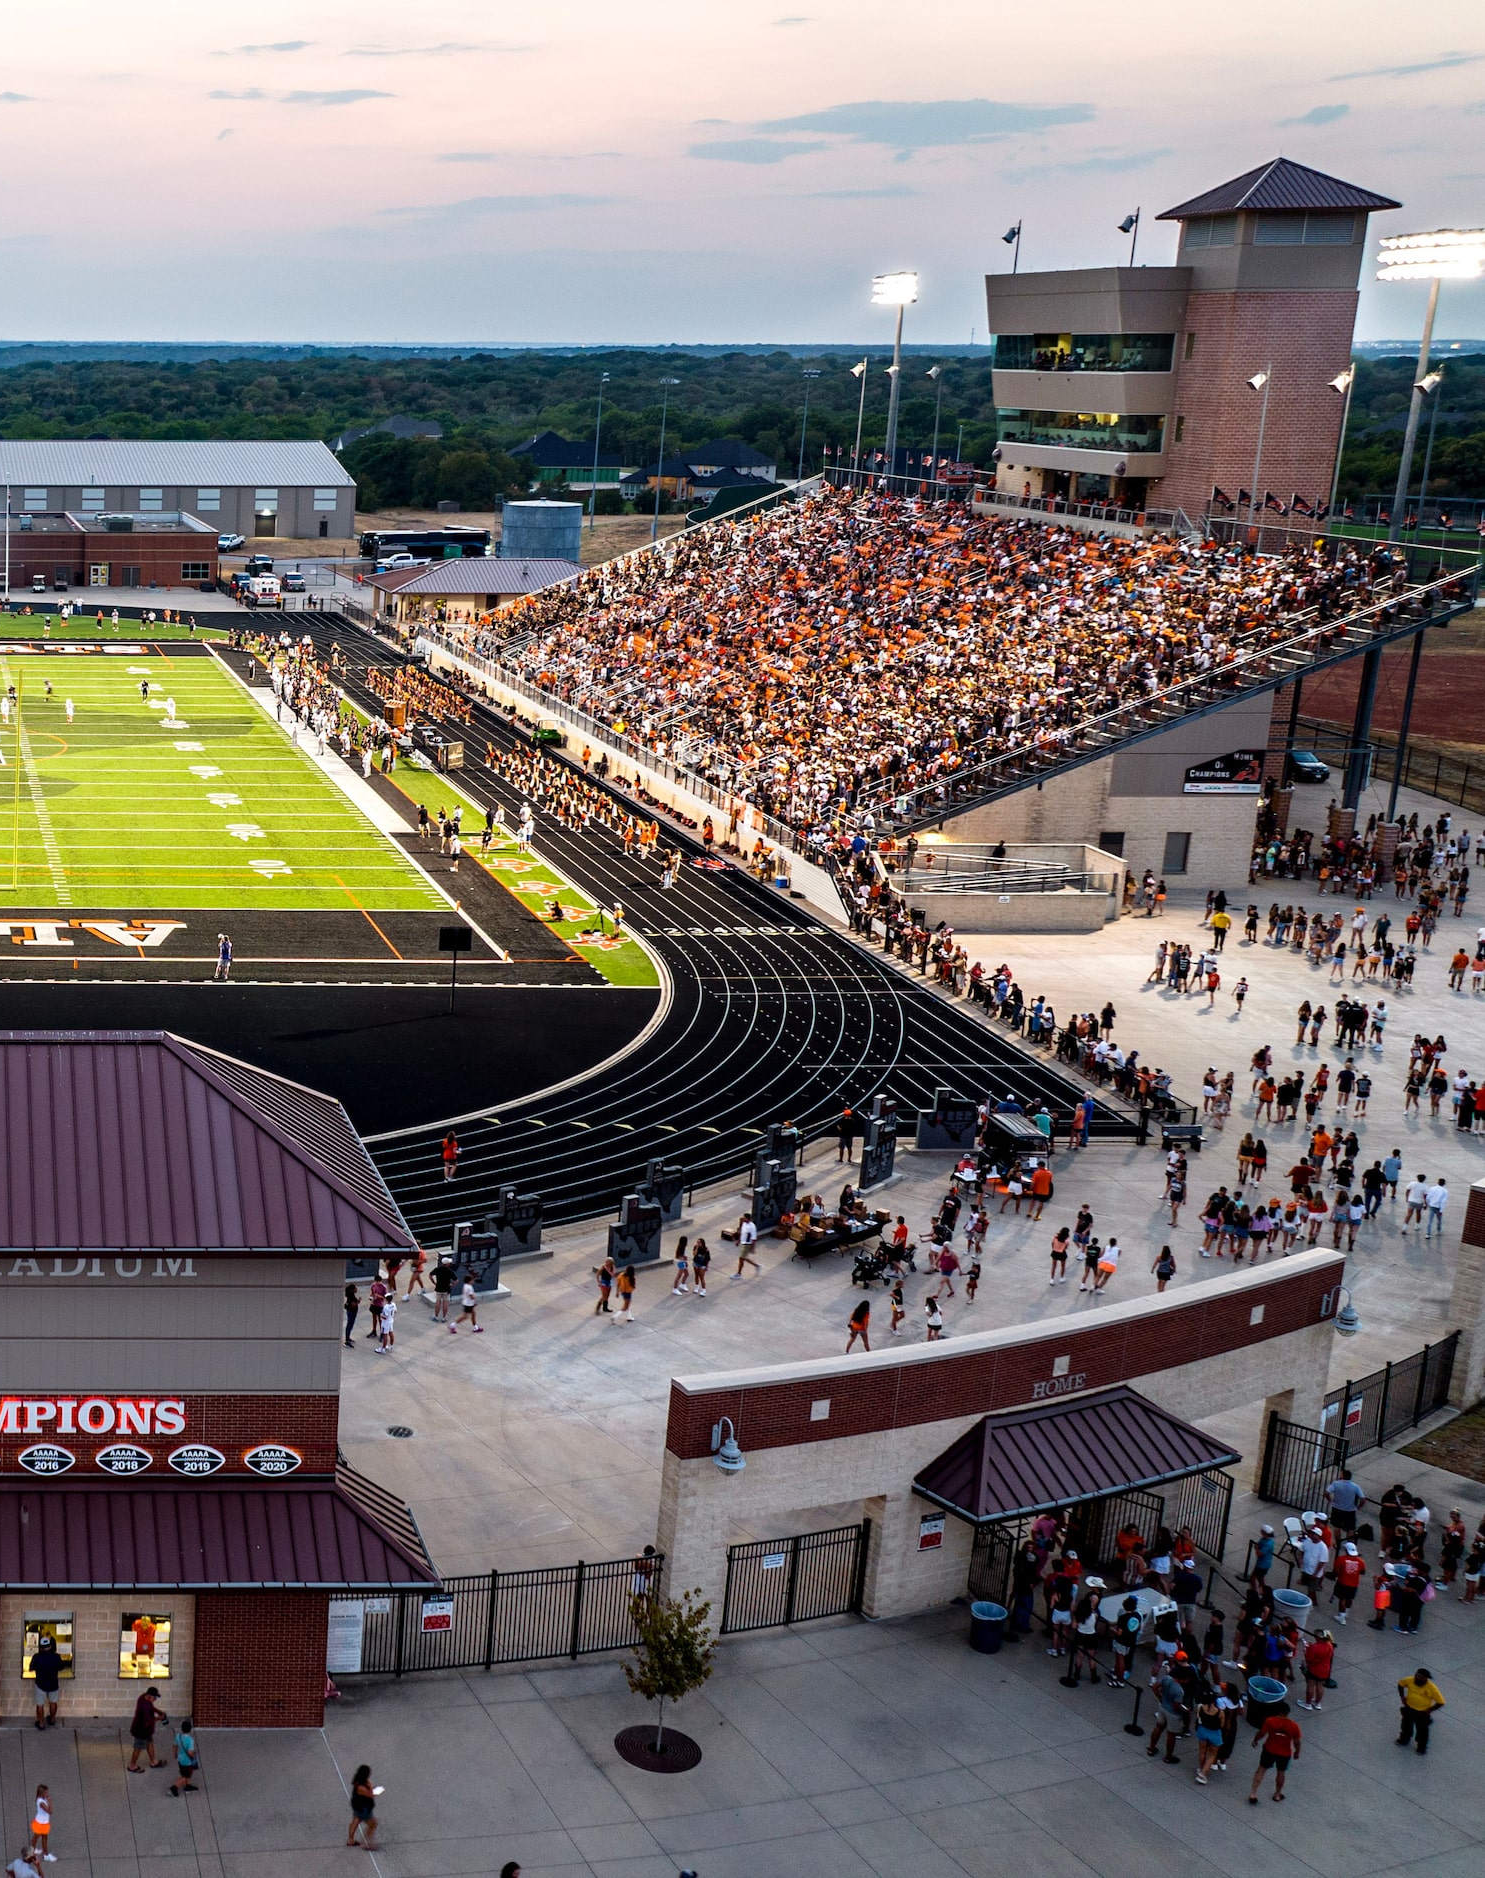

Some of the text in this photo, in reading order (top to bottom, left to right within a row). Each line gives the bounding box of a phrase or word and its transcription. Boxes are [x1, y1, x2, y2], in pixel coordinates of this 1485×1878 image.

[1189, 769, 1230, 778] CHAMPIONS
[247, 860, 293, 874] 10
[1032, 1372, 1087, 1399] HOME
[257, 1450, 287, 1458] AAAAA
[34, 1461, 59, 1470] 2016
[111, 1461, 138, 1470] 2018
[183, 1462, 211, 1471] 2019
[259, 1462, 287, 1471] 2020
